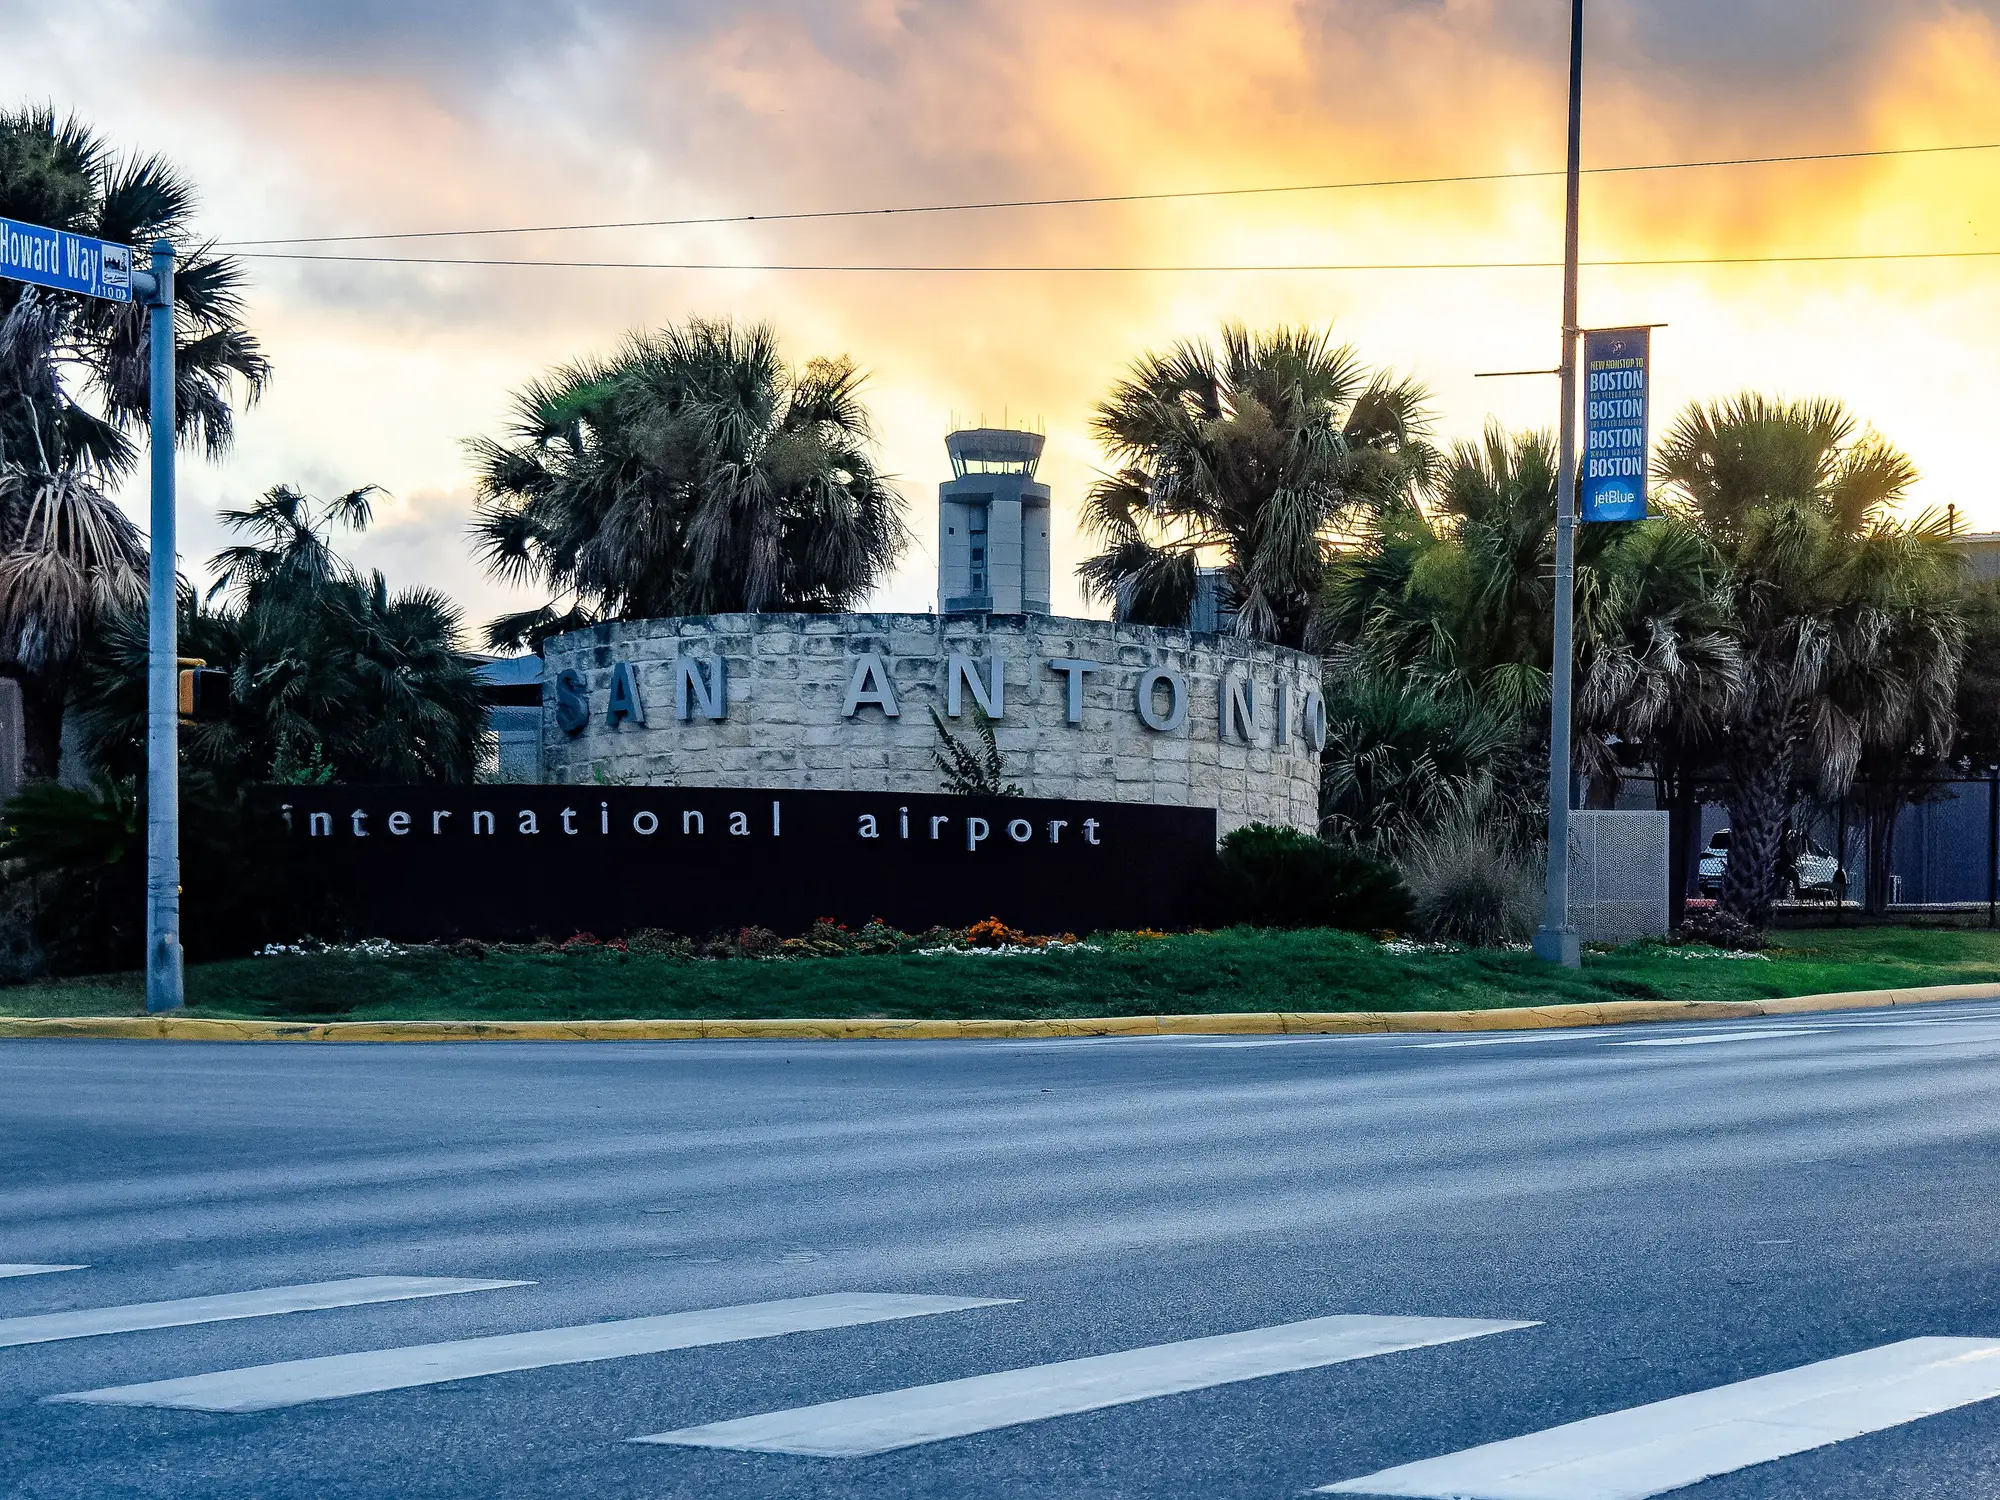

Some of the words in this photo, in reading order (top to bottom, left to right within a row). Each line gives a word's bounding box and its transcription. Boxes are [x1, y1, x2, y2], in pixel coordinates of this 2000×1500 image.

[0, 222, 59, 275] Howard
[66, 237, 99, 294] Way
[1590, 360, 1605, 371] NEW
[1605, 358, 1635, 370] NONSTOP
[1635, 357, 1644, 368] TO
[1590, 369, 1643, 392] BOSTON
[1590, 398, 1643, 420] BOSTON
[1589, 427, 1642, 450] BOSTON
[1589, 456, 1642, 478] BOSTON
[1594, 489, 1635, 508] jetBlue
[556, 654, 728, 735] SAN
[841, 652, 1327, 753] ANTONIO
[281, 801, 780, 838] international
[858, 806, 1101, 852] airport
